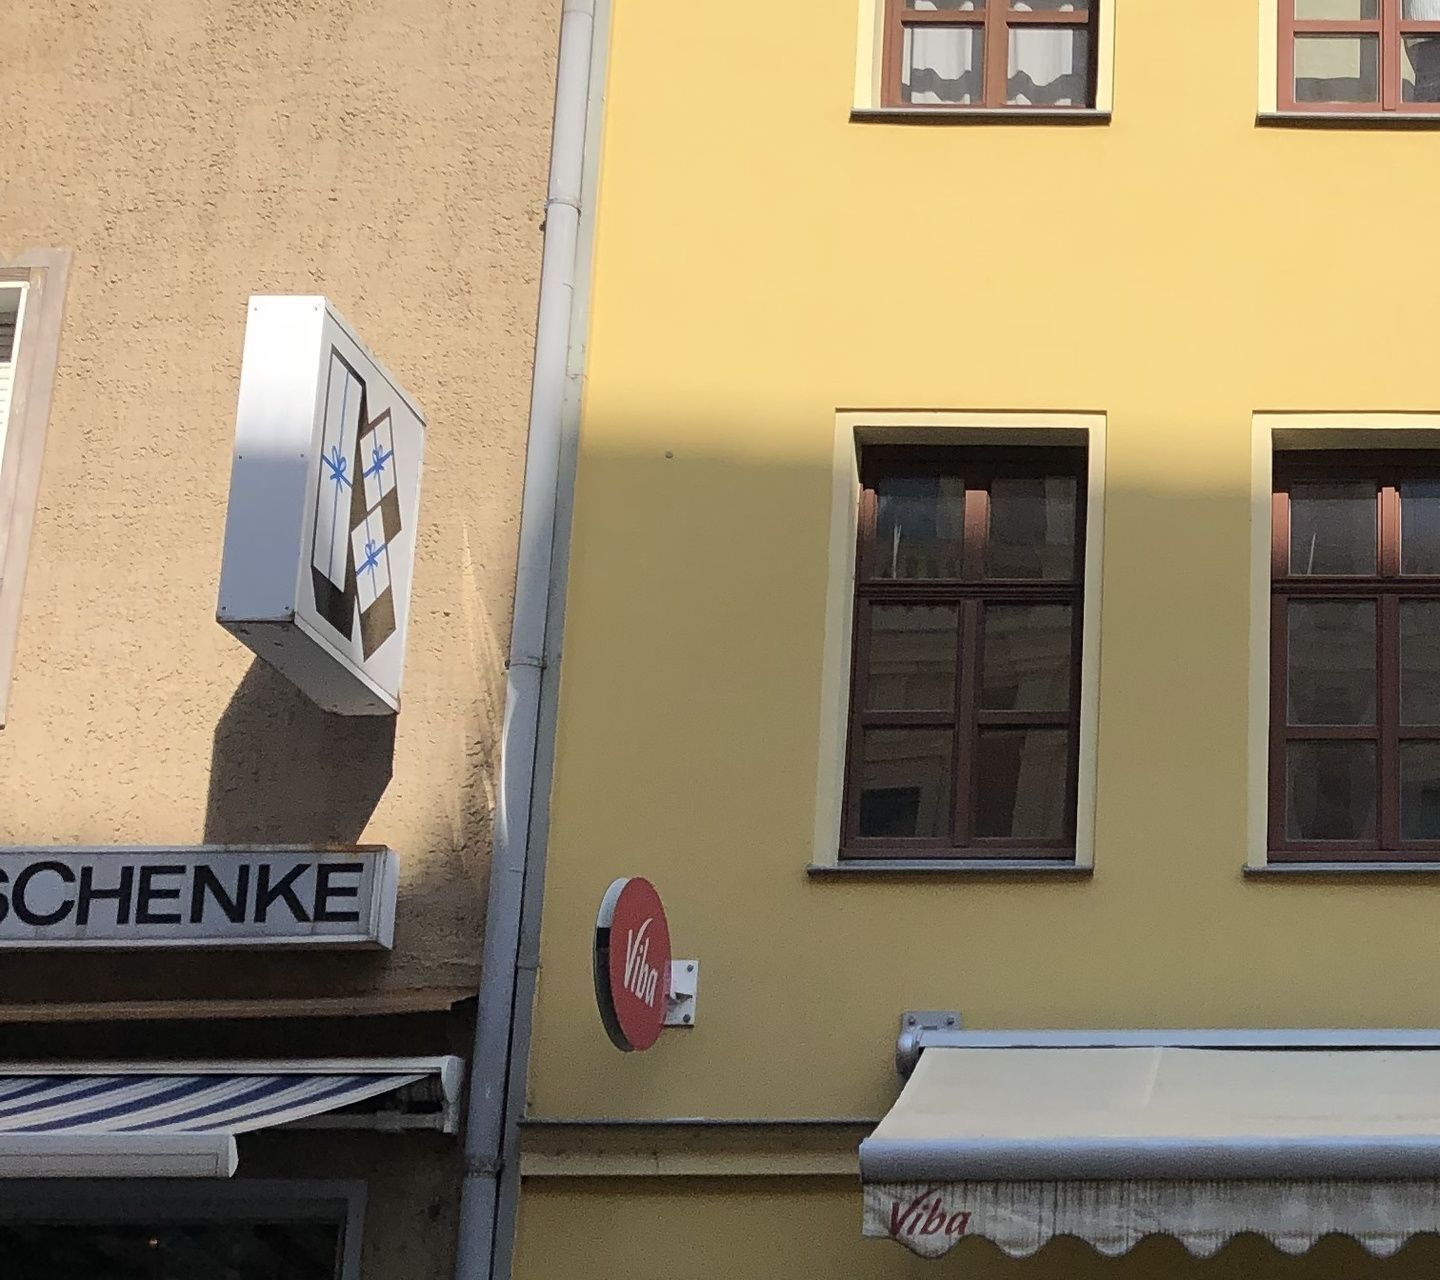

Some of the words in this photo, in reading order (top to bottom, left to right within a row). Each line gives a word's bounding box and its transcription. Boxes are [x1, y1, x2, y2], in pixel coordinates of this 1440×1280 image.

[0, 860, 366, 927] CHENKE
[623, 918, 659, 1008] Viba
[889, 1184, 973, 1237] Viba
